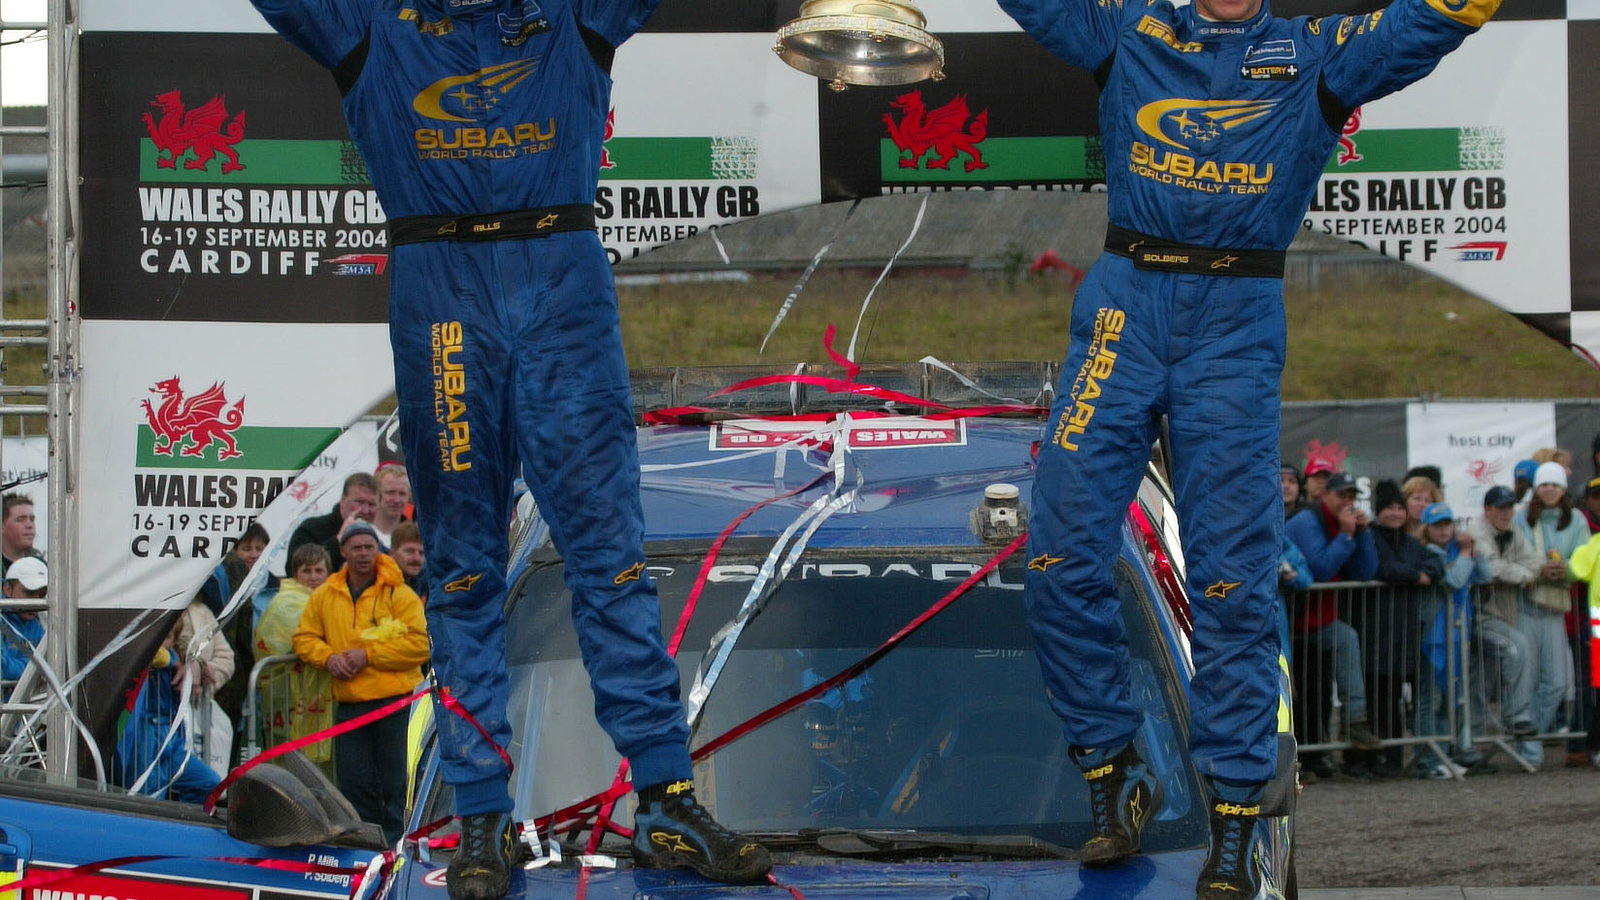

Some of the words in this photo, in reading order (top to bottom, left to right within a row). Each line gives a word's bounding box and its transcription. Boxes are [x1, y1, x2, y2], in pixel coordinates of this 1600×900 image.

[415, 117, 556, 149] SUBARU
[418, 149, 468, 159] WORLD
[472, 148, 517, 159] RALLY
[522, 141, 557, 154] TEAM
[1129, 163, 1172, 184] WORLD
[1175, 177, 1222, 193] RALLY
[1229, 184, 1268, 194] TEAM
[1130, 141, 1274, 185] SUBARU
[138, 187, 244, 223] WALES
[250, 189, 339, 224] RALLY
[344, 189, 387, 224] GB
[620, 186, 710, 219] RALLY
[716, 185, 760, 218] GB
[1309, 179, 1360, 212] LES
[1367, 177, 1457, 212] RALLY
[1463, 176, 1507, 210] GB
[140, 227, 197, 246] 16-19
[205, 228, 327, 248] SEPTEMBER
[334, 229, 388, 248] 2004
[598, 224, 698, 243] PTEMBER
[1322, 217, 1445, 236] SEPTEMBER
[1454, 216, 1507, 234] 2004
[140, 248, 319, 275] CARDIFF
[1143, 254, 1189, 264] SOLBERG
[431, 322, 442, 376] WORLD
[1087, 307, 1107, 357] WORLD
[441, 320, 472, 472] SUBARU
[1060, 308, 1126, 452] SUBARU
[1070, 358, 1093, 401] RALLY
[433, 379, 446, 425] RALLY
[856, 430, 948, 442] WALES
[1052, 405, 1073, 445] TEAM
[438, 429, 451, 472] TEAM
[134, 474, 238, 509] WALES
[133, 514, 190, 531] 16-19
[198, 514, 258, 532] SEPTE
[131, 534, 239, 559] CARD
